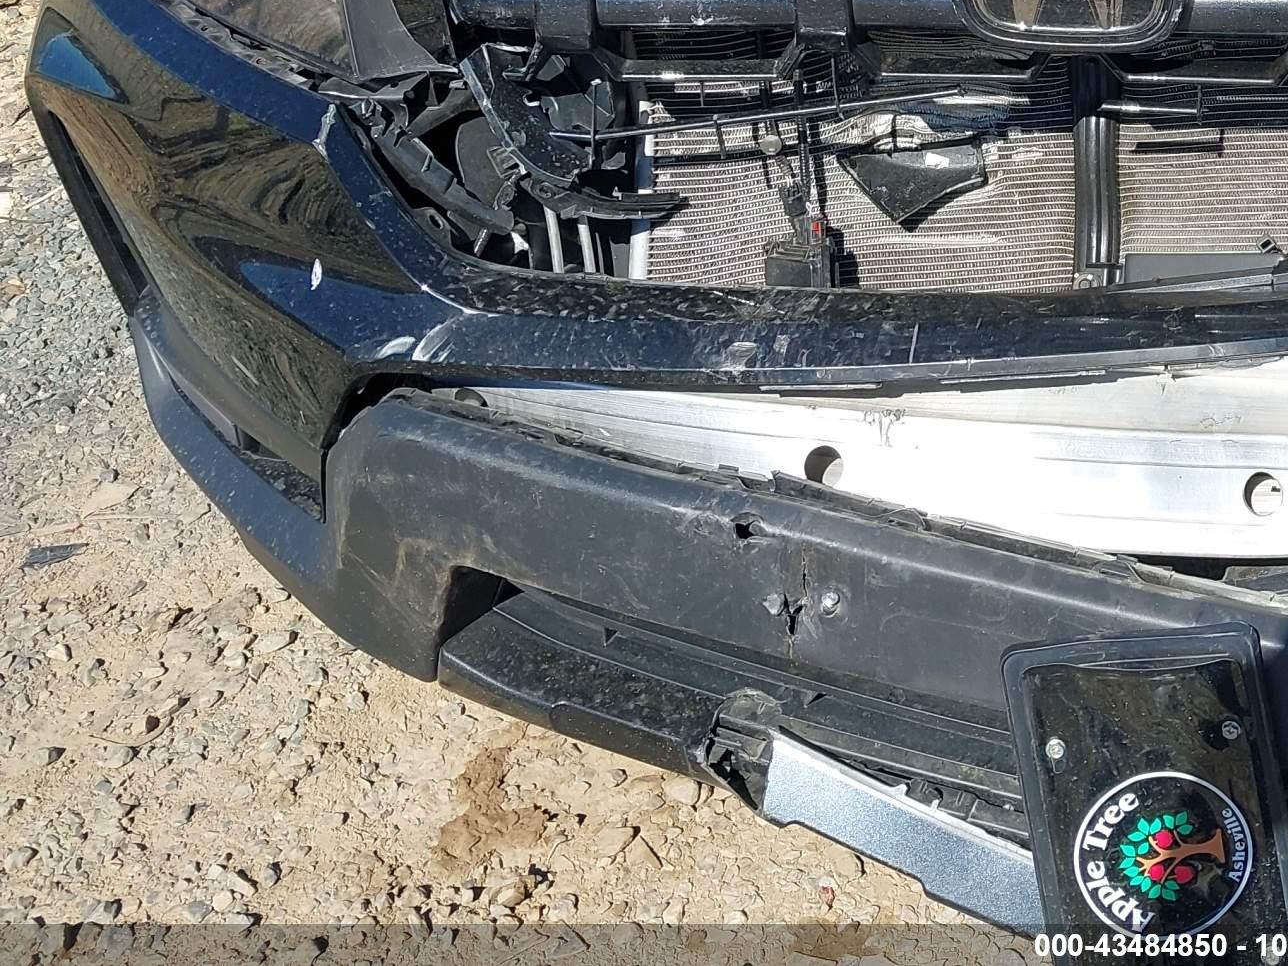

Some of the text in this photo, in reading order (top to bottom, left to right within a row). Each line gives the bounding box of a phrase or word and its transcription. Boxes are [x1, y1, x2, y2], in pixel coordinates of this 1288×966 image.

[1082, 792, 1156, 934] Apple Tree
[1221, 808, 1246, 883] Asheville
